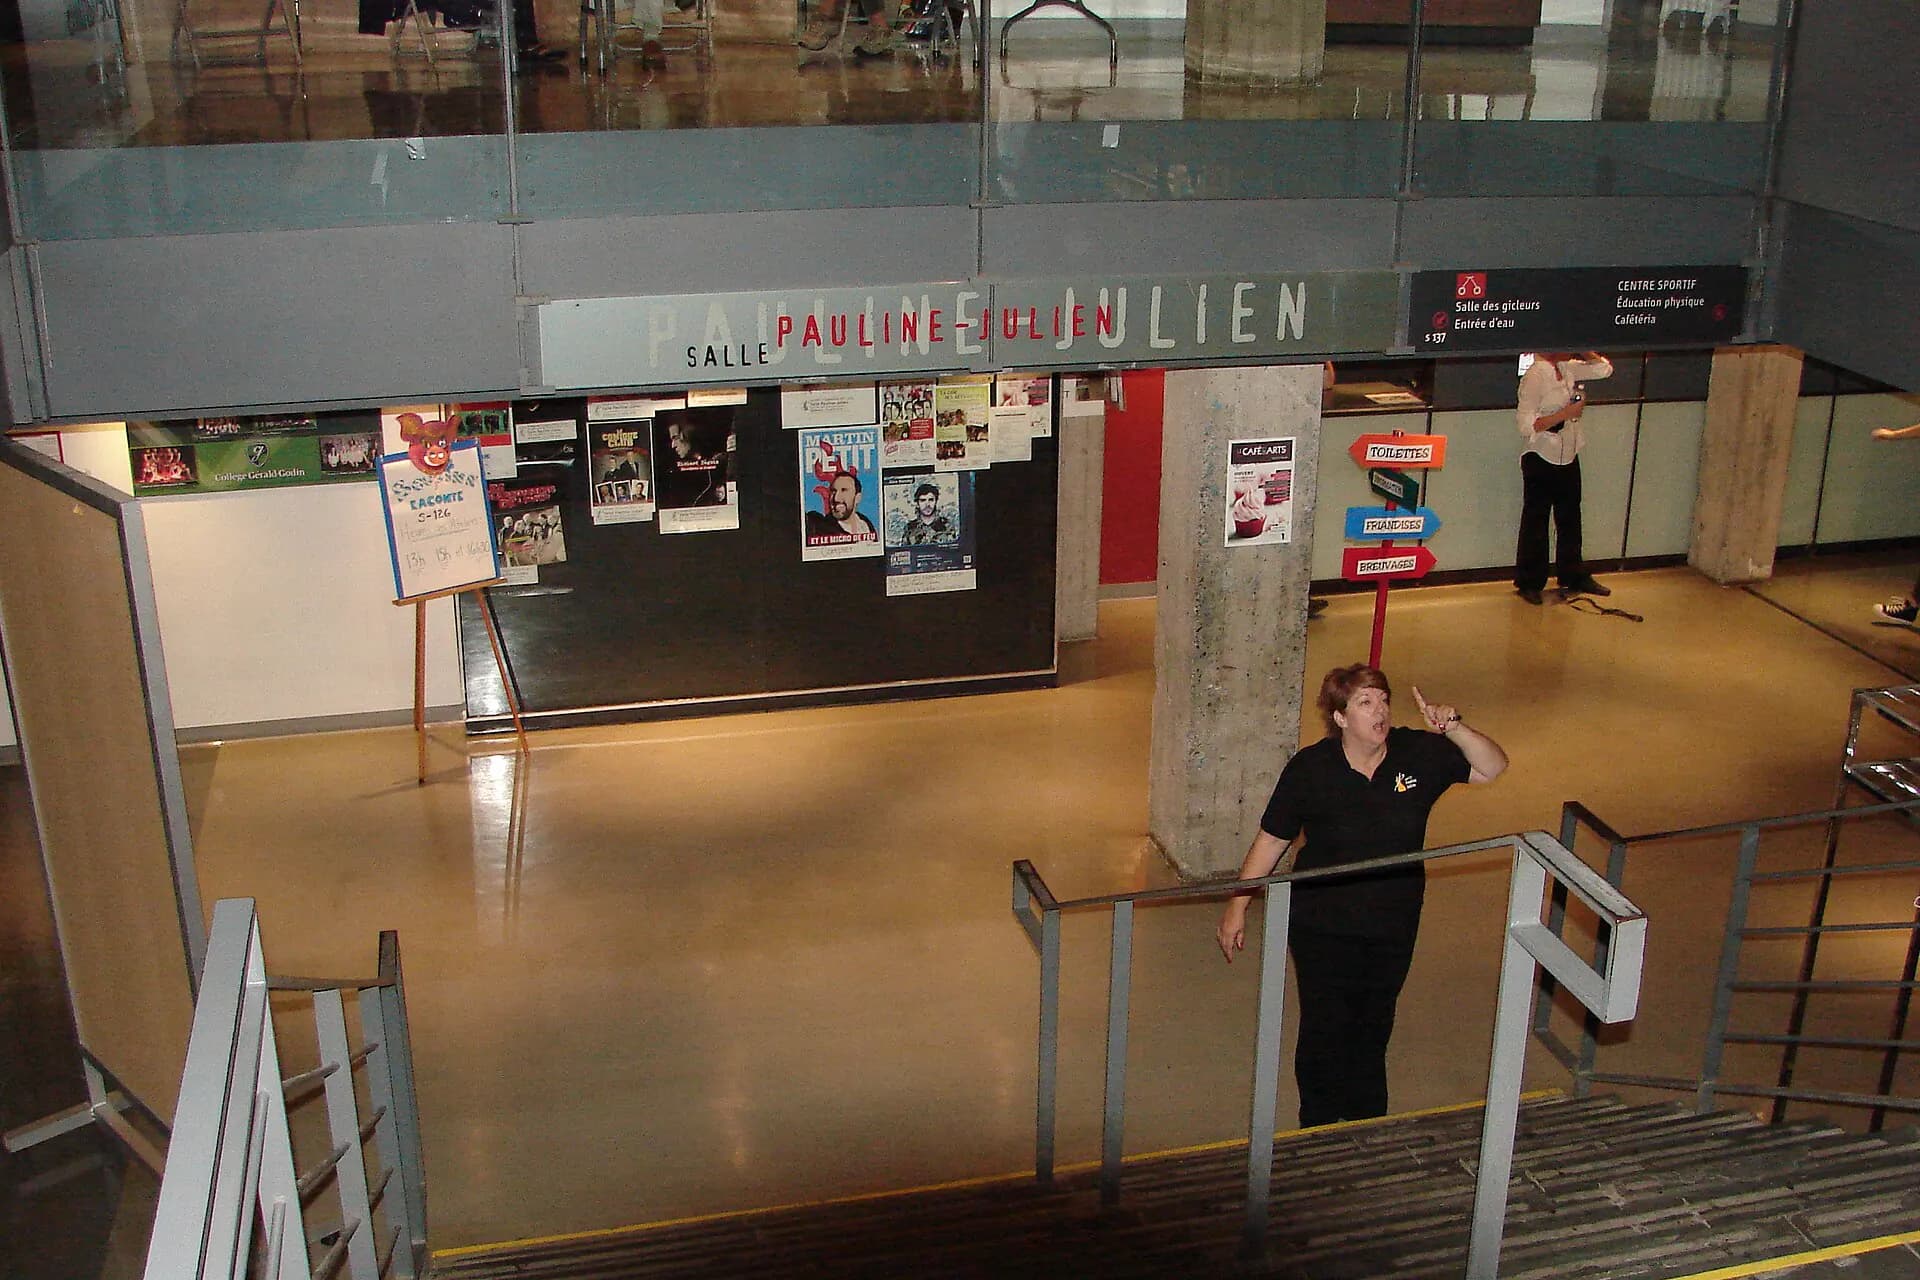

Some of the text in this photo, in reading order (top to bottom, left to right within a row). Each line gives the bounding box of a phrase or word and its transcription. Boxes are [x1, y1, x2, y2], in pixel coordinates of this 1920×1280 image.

[1618, 279, 1697, 292] CENTRE SPORTIF
[1455, 300, 1540, 313] Salle des gicleurs
[1616, 295, 1705, 310] Éducation physique
[1454, 317, 1515, 330] Entrée d'eau
[1614, 313, 1657, 325] Cafétéria
[776, 305, 1112, 347] PAULINE-JULIEN
[1432, 332, 1447, 344] 137
[687, 342, 769, 368] SALLE
[805, 431, 876, 448] MARTIN
[1242, 446, 1263, 456] CAFÉ
[1265, 445, 1287, 455] ARTS
[1370, 446, 1430, 459] TOILETTES
[805, 443, 876, 474] PETIT
[1365, 518, 1422, 532] FRIANDISES
[1359, 558, 1415, 572] BREUVAGES
